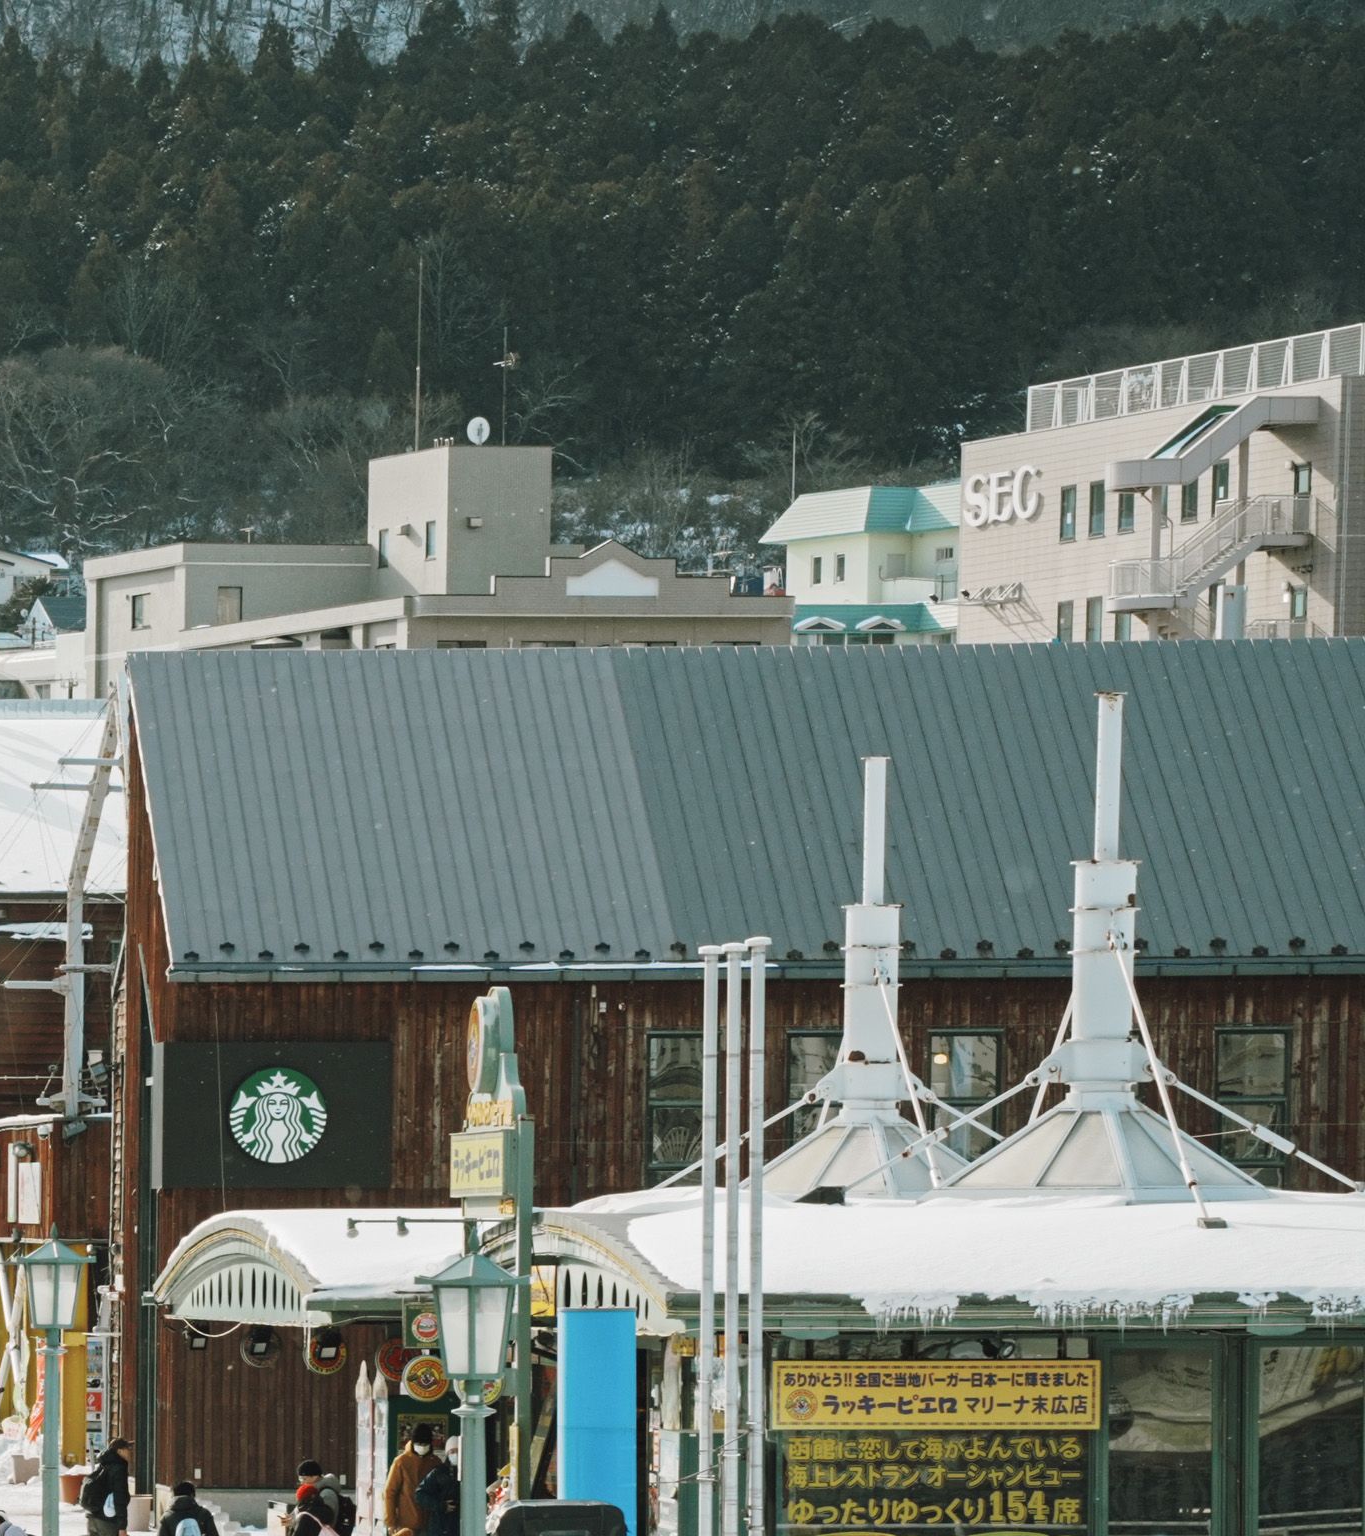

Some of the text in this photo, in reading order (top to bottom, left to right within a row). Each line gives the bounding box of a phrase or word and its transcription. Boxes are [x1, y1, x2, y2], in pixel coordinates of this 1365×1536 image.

[963, 464, 1039, 527] SEC
[822, 1394, 1089, 1415] ラッキーピエロ マリーナ末広店
[788, 1437, 1082, 1460] 函館に恋して海がよんでいる
[788, 1465, 1081, 1488] 海上レストラン オーシャンビュー
